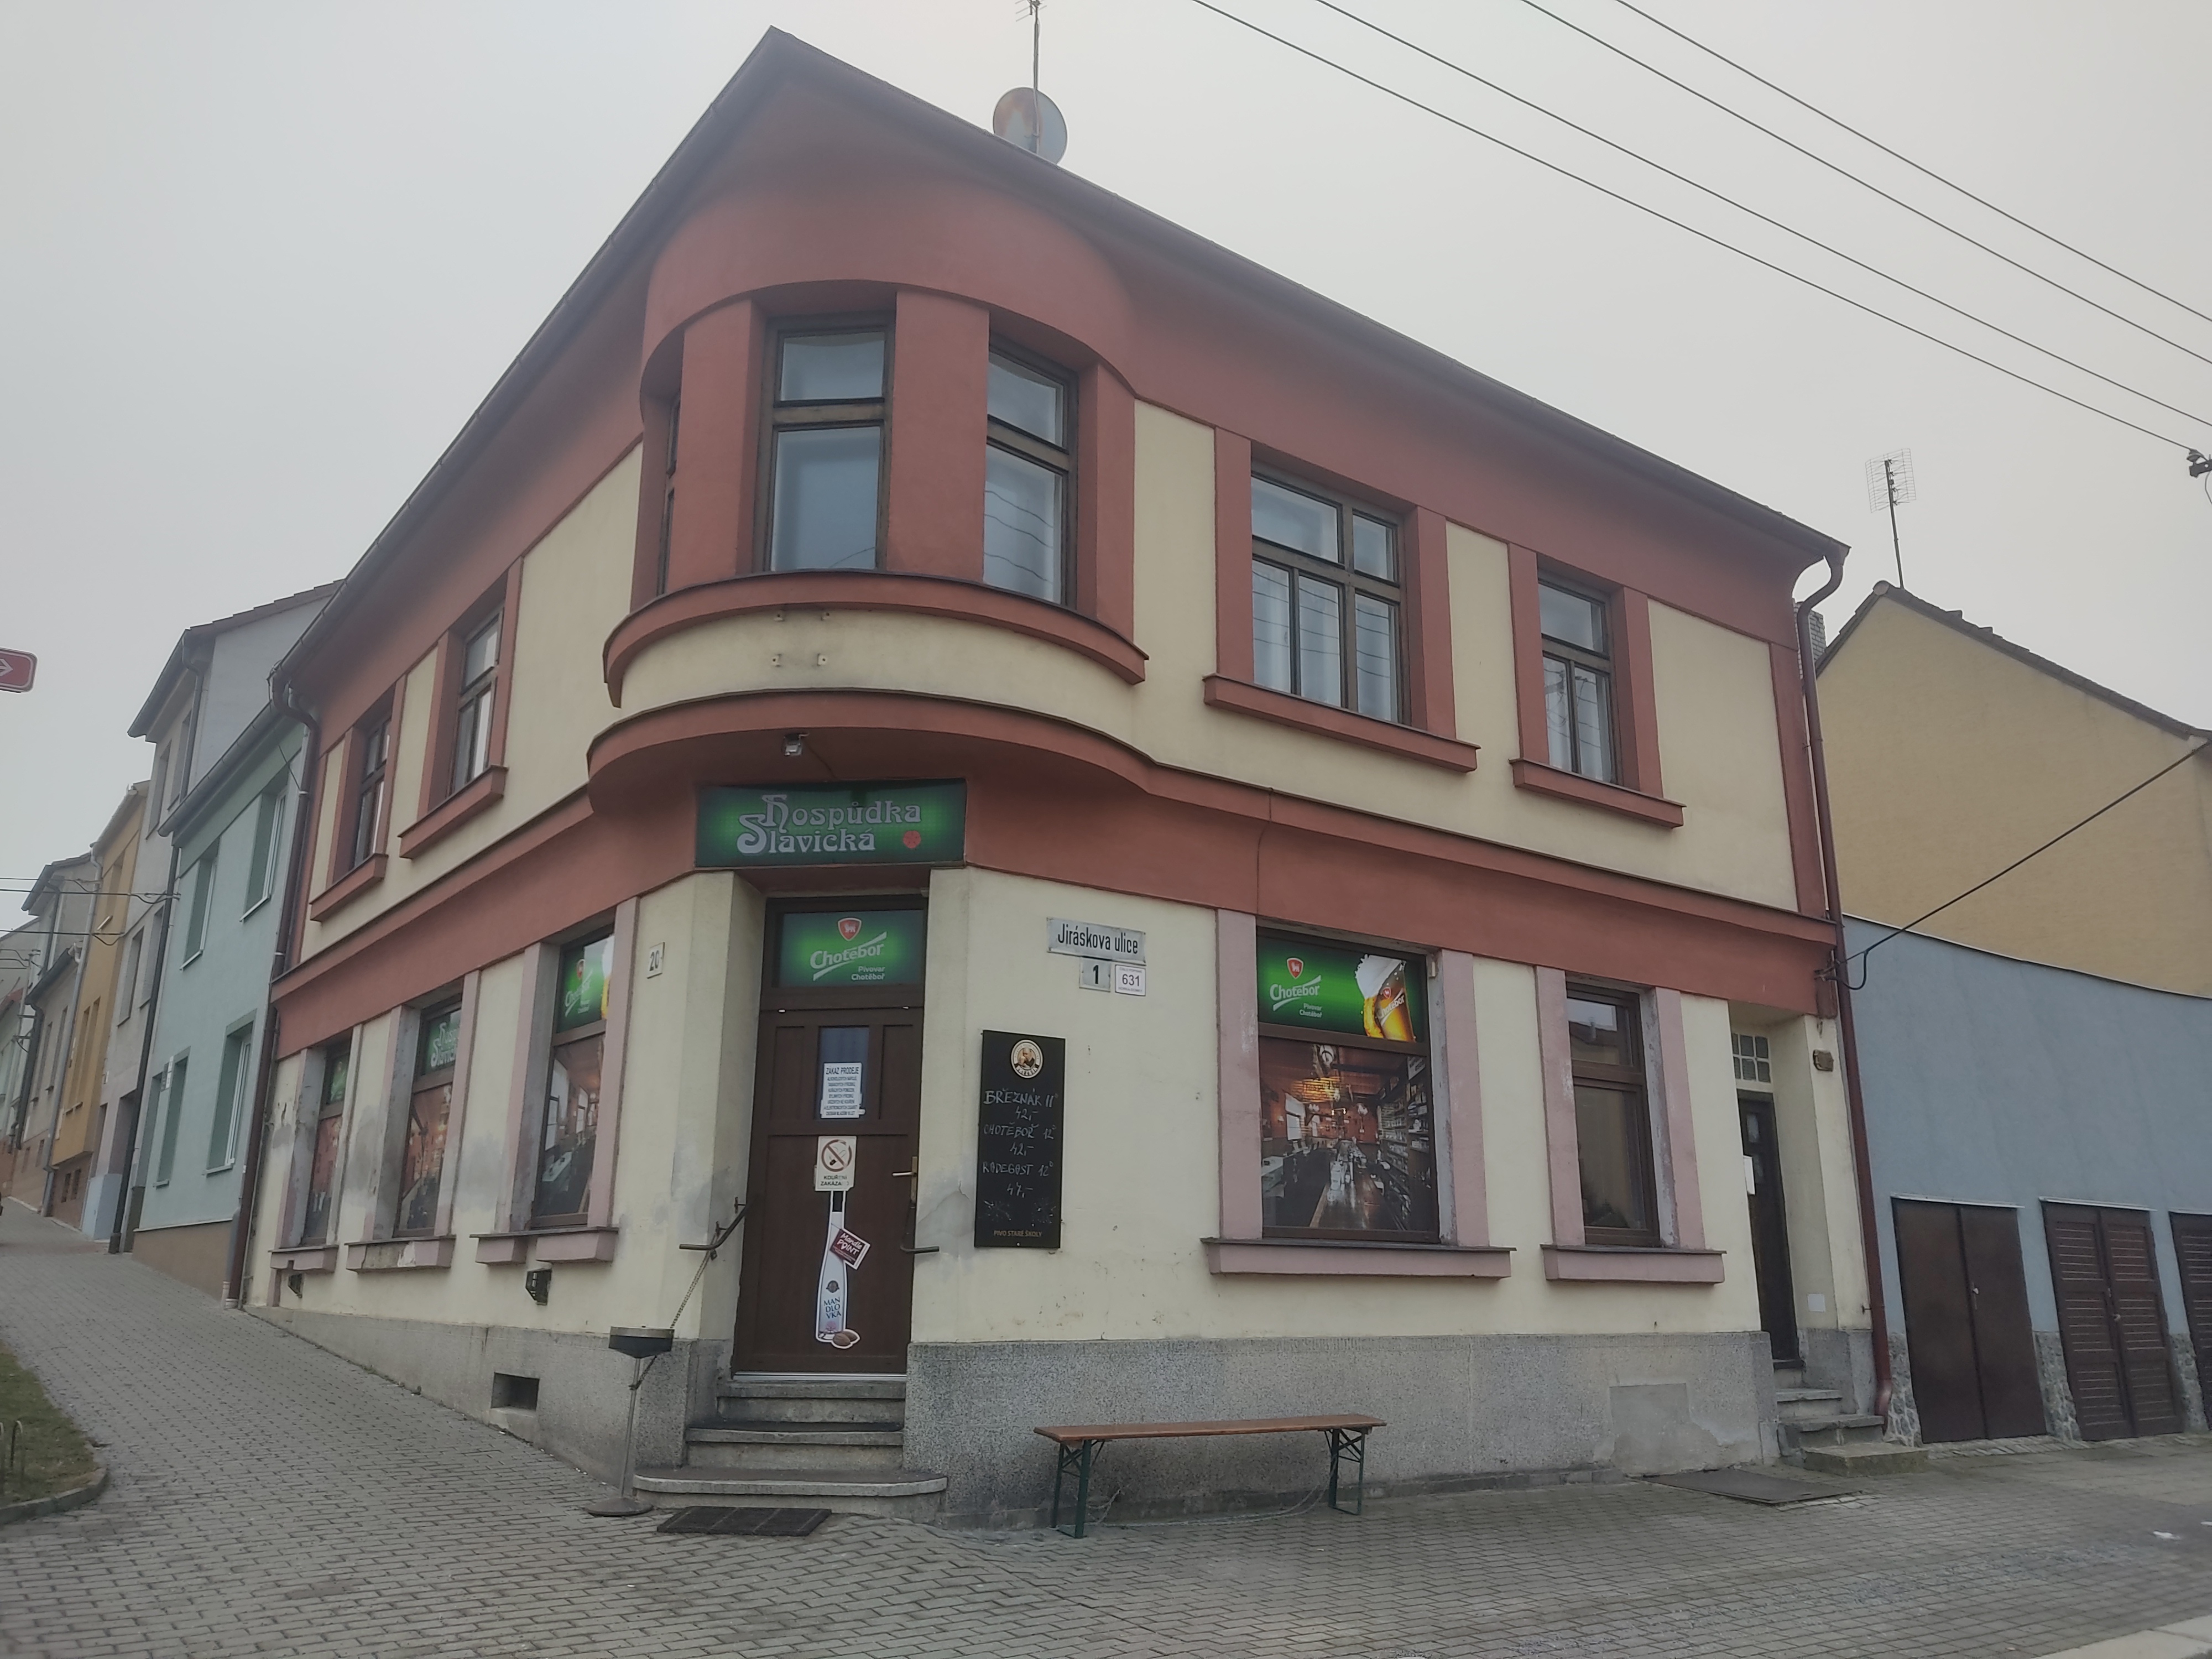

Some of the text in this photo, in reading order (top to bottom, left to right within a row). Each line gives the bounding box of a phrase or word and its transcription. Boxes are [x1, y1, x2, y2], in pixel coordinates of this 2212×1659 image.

[757, 794, 921, 833] Hospůdka
[737, 813, 876, 854] Slavická
[1057, 923, 1139, 954] Jiráskova ulice
[649, 950, 660, 972] 20
[1092, 964, 1099, 985] 1
[1122, 973, 1139, 987] 631
[841, 1066, 859, 1074] PRODEJE
[983, 1087, 1042, 1107] BŘEZNÁK
[983, 1121, 1040, 1139] CHOTĚBOŘ
[836, 1239, 860, 1255] POINT
[840, 1232, 863, 1250] Mandle
[823, 1296, 841, 1306] MAN
[826, 1310, 842, 1319] VKA
